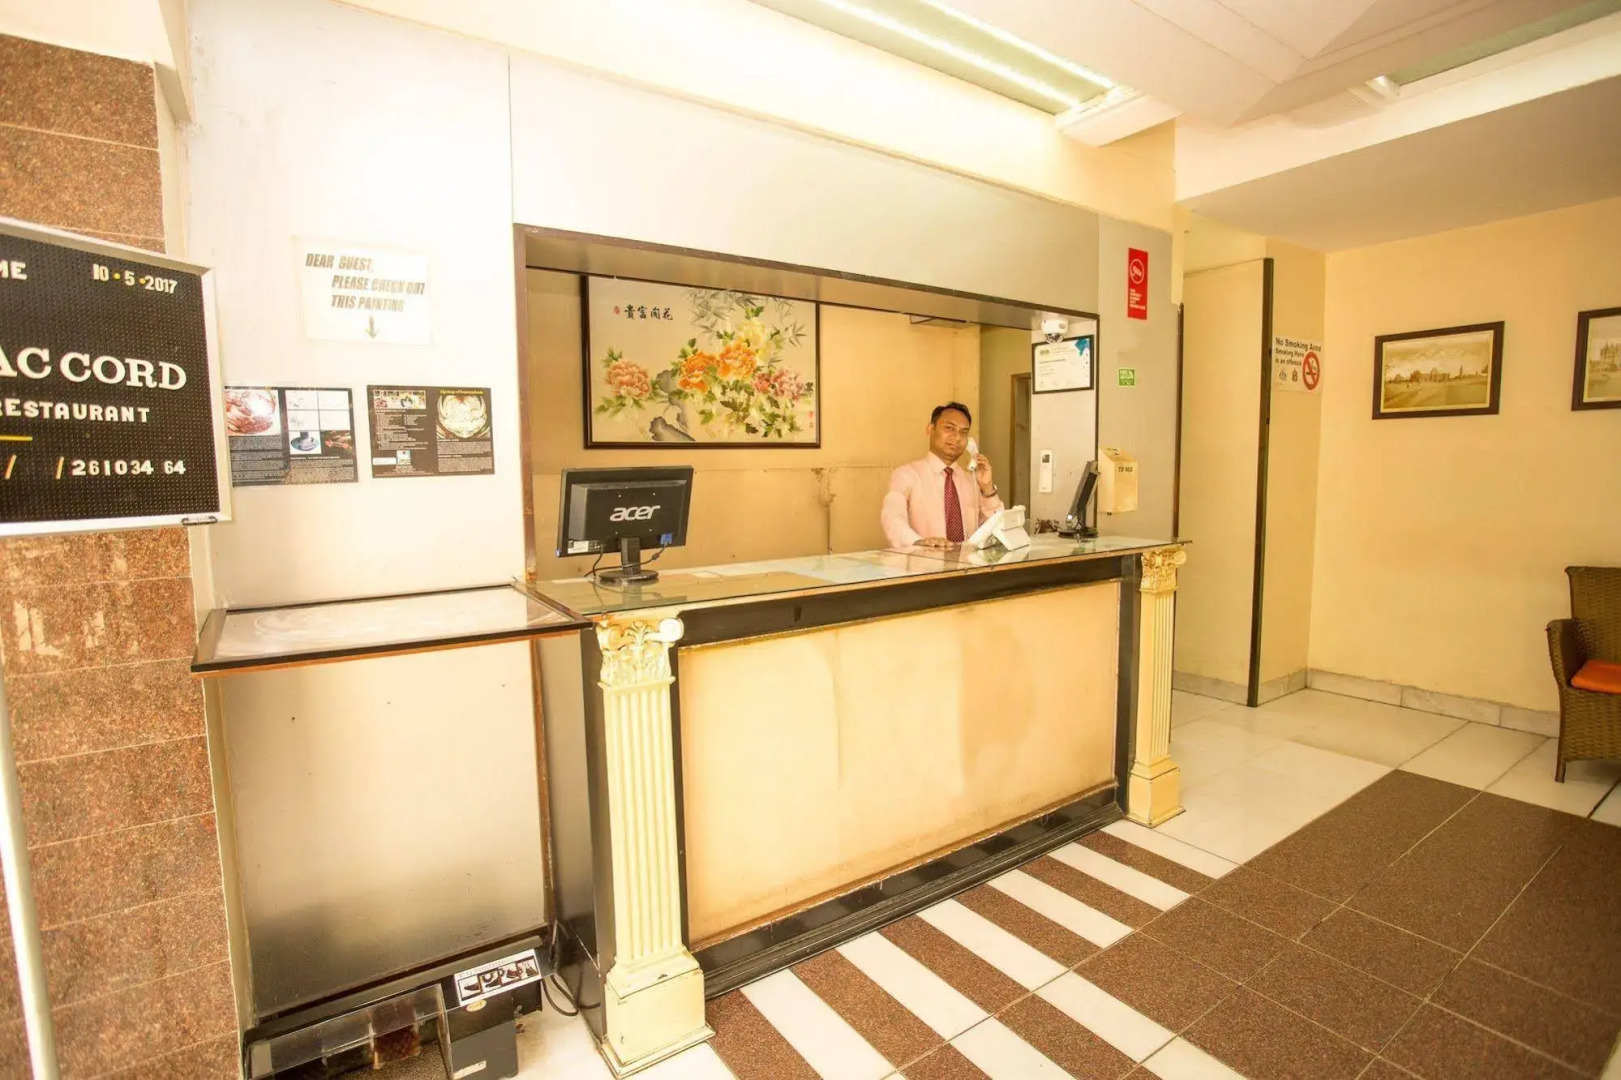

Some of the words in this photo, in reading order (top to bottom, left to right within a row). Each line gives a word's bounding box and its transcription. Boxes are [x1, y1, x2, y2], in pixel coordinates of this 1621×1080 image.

[305, 253, 334, 269] DEAR
[331, 275, 369, 290] PLEASE
[371, 278, 405, 294] CHECK
[331, 294, 356, 309] THIS
[358, 296, 405, 312] PAINTING
[1275, 337, 1284, 346] No
[1284, 338, 1309, 352] Smoking
[1309, 343, 1322, 352] Area
[1275, 347, 1293, 358] Smoking
[0, 399, 150, 423] ESTAURANT
[609, 505, 661, 522] acer
